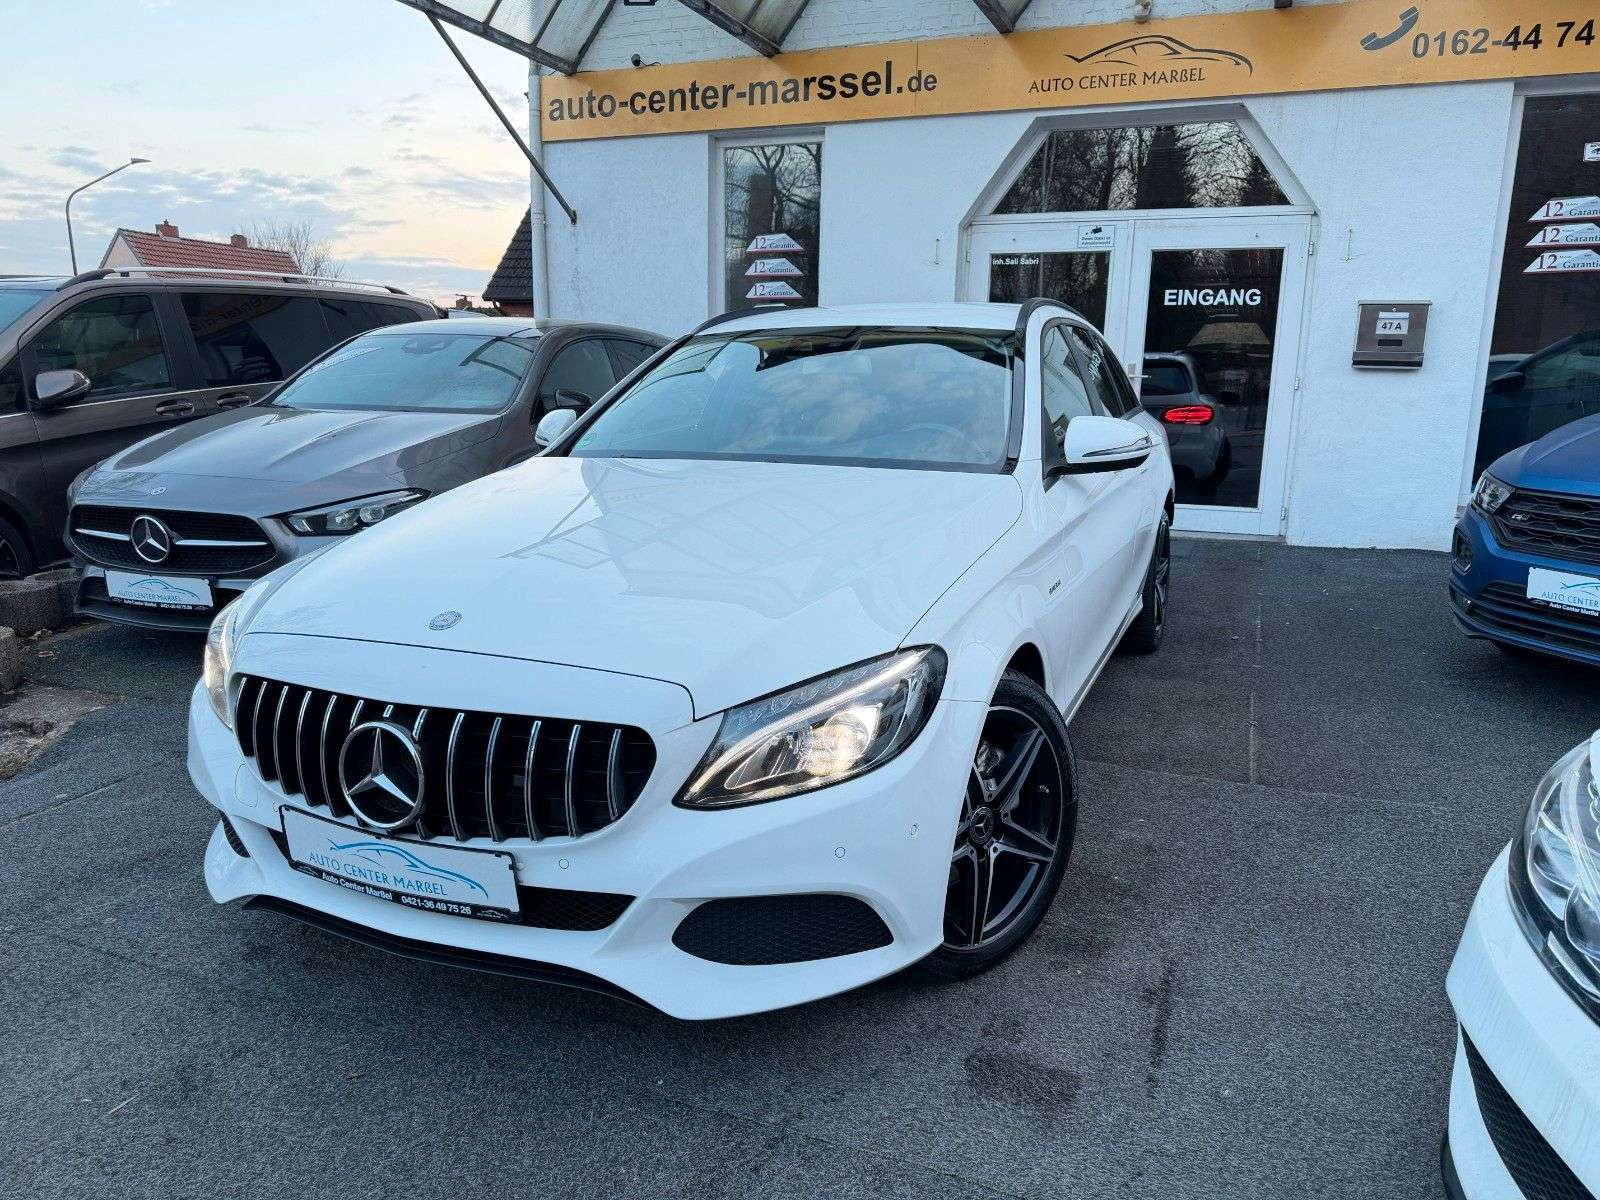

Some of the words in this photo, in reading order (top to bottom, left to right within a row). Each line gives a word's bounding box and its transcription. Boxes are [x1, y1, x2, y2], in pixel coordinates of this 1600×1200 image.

[1412, 24, 1542, 58] 0162-44
[1556, 19, 1595, 48] 74
[548, 60, 938, 122] auto-center-marssel.de
[1028, 77, 1074, 94] AUTO
[1078, 72, 1137, 90] CENTER
[1542, 201, 1564, 218] 12
[753, 237, 767, 250] 12
[1539, 227, 1561, 244] 12
[753, 261, 766, 273] 12
[1535, 253, 1558, 270] 12
[753, 284, 766, 297] 12
[1164, 288, 1262, 306] EINGANG
[1541, 591, 1565, 601] AUTO
[1567, 595, 1599, 608] CENTER
[309, 851, 340, 871] AUTO
[343, 863, 391, 886] CENTER
[322, 872, 339, 884] Auto
[340, 878, 365, 893] Center
[401, 895, 435, 909] 0421-36
[436, 903, 447, 911] 49
[448, 903, 459, 913] 75
[460, 906, 472, 915] 26
